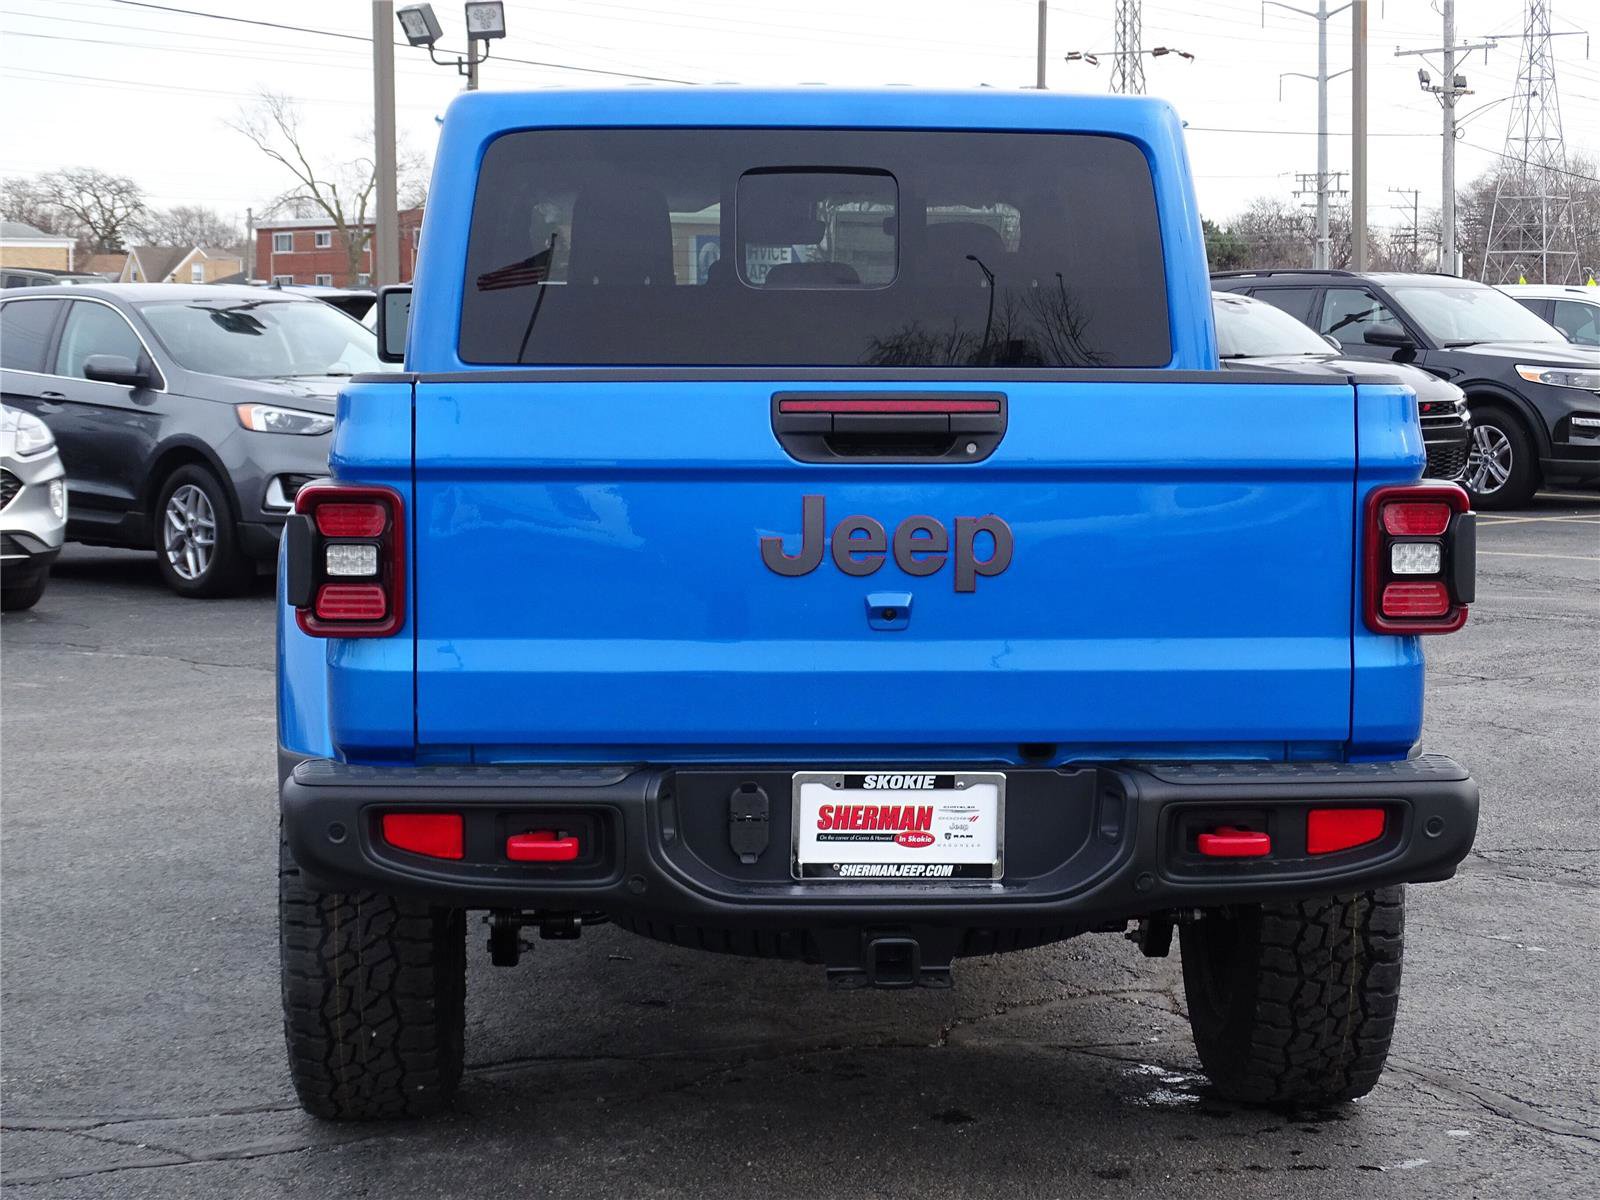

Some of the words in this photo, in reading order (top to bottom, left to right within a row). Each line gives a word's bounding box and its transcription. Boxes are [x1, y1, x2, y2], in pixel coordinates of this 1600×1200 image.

[749, 247, 788, 261] RVICE
[760, 494, 1014, 593] Jeep
[862, 775, 936, 789] SKOKIE
[816, 804, 934, 831] SHERMAN
[907, 835, 932, 843] Skokie
[839, 864, 954, 877] SHERMANJEEP.COM
